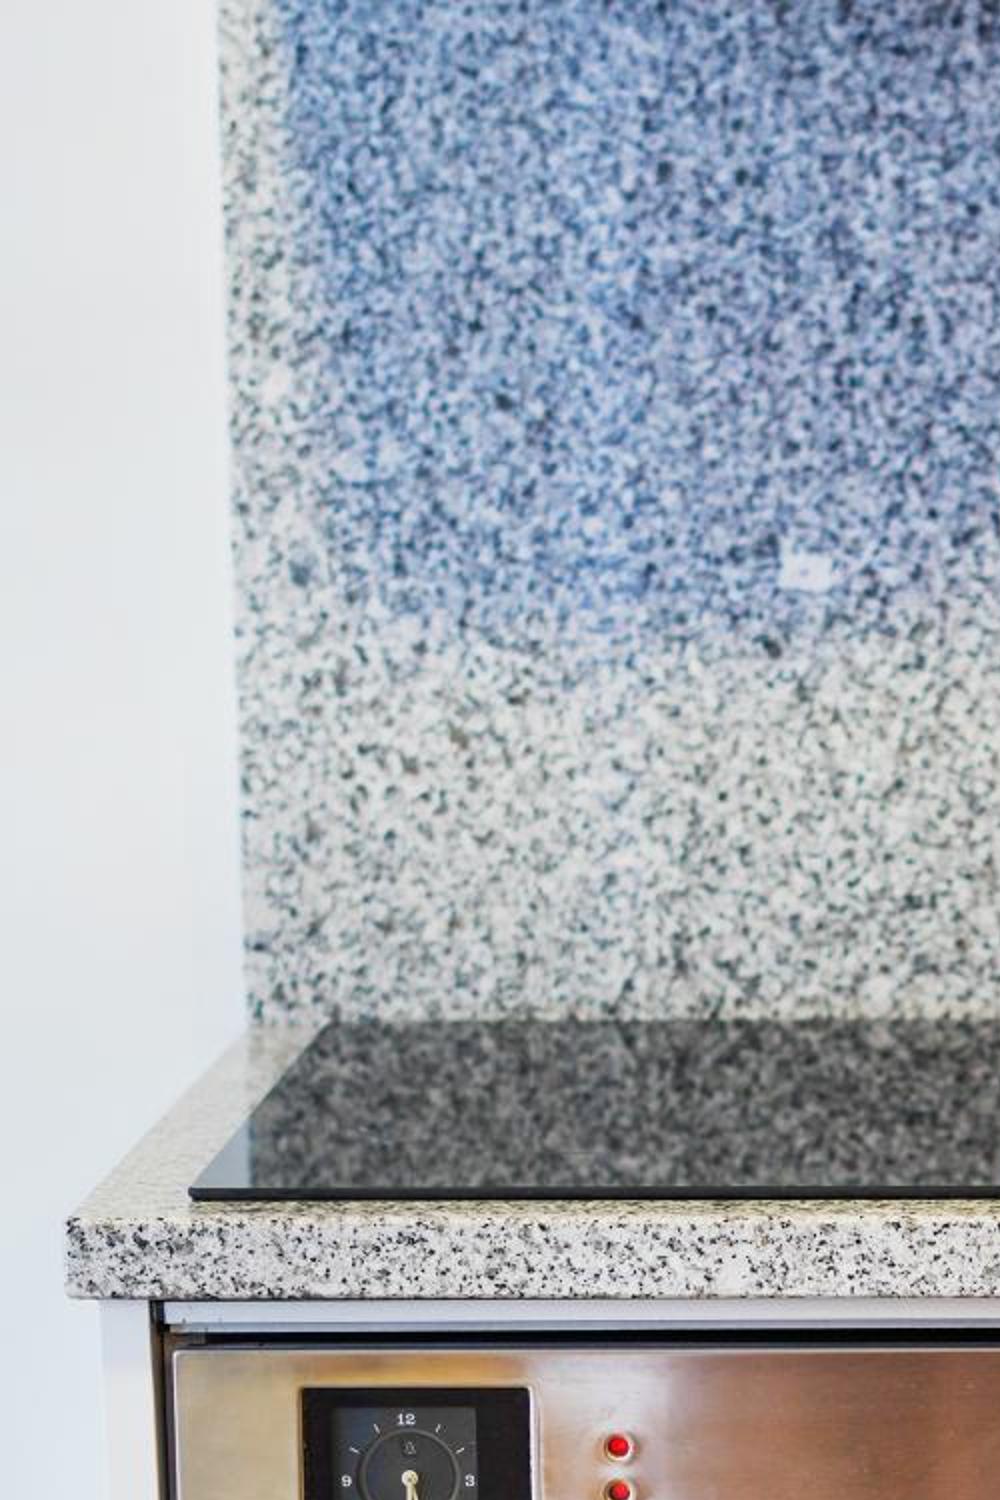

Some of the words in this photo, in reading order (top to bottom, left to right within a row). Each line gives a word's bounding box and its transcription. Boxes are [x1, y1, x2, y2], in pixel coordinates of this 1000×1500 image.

[396, 1413, 417, 1426] 12
[341, 1474, 353, 1488] 9
[464, 1474, 476, 1488] 3
